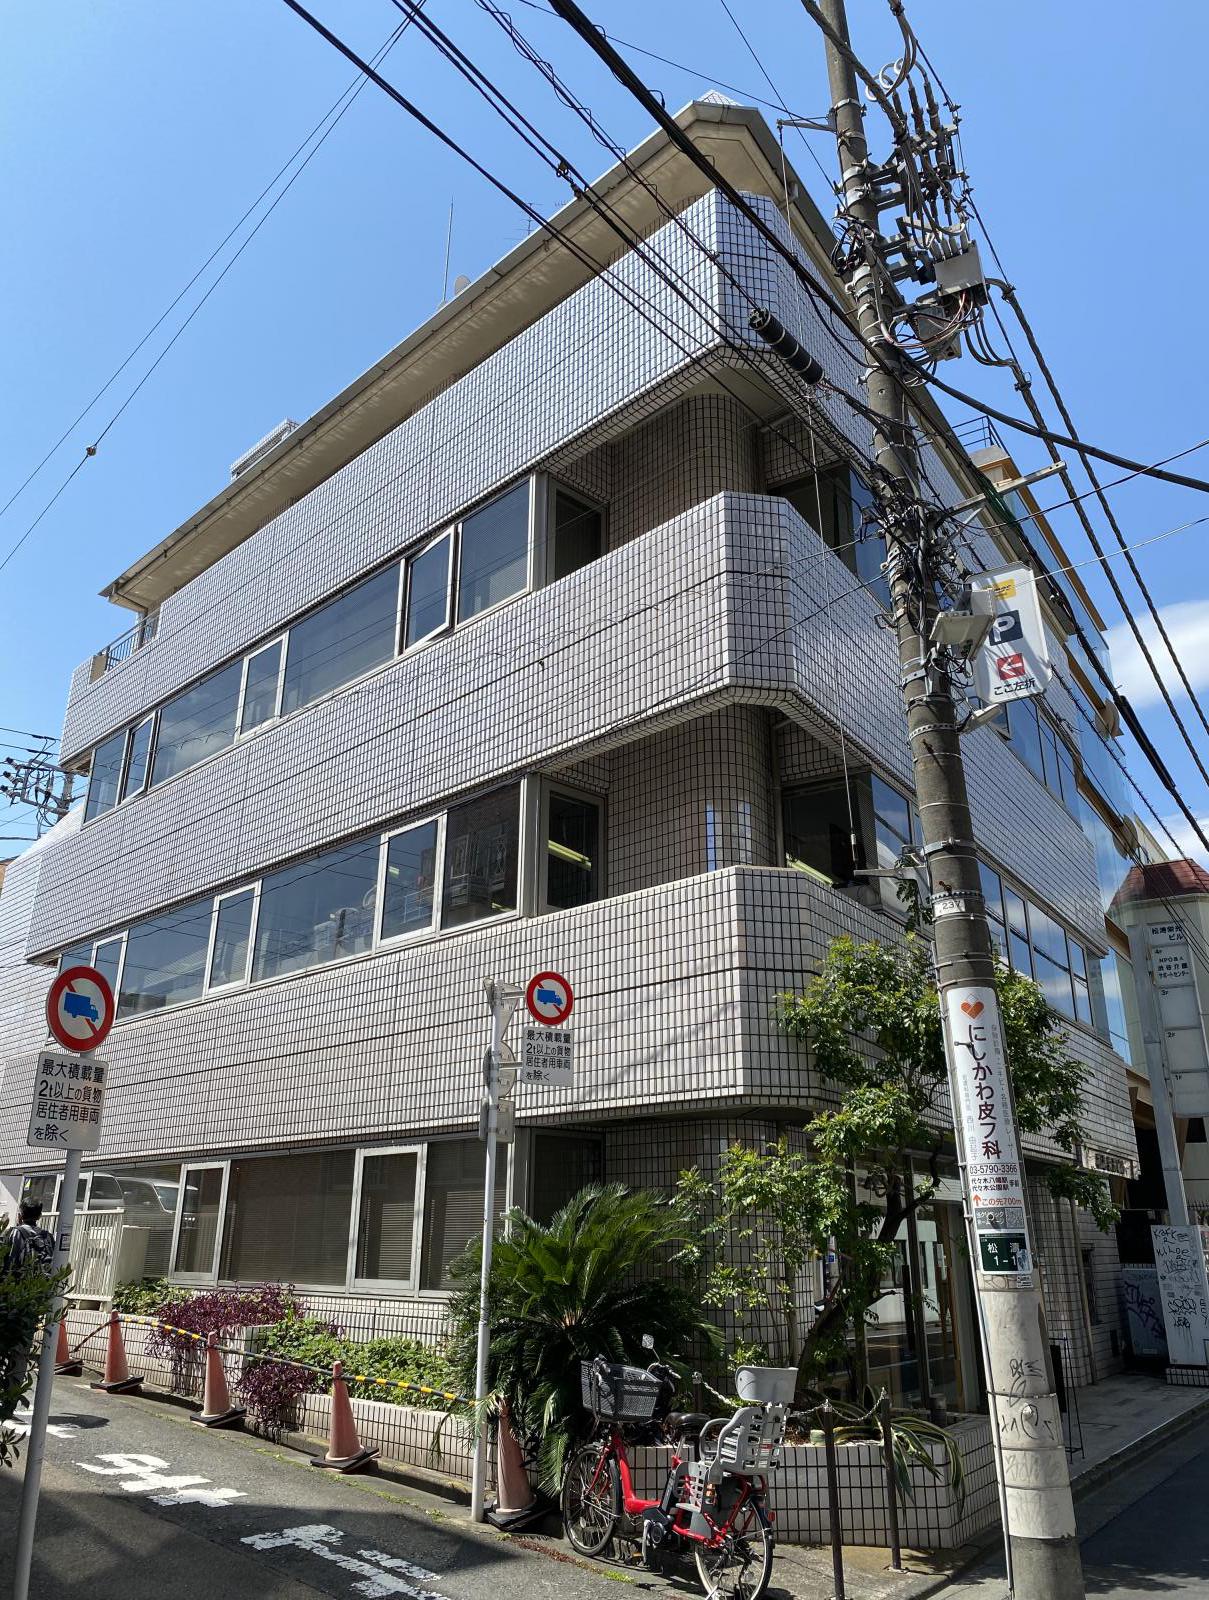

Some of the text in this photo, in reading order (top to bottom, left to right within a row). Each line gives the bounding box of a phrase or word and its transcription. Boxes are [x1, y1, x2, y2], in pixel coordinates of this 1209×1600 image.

[993, 678, 1036, 696] ここ左折
[526, 1029, 571, 1044] 最大積載量
[526, 1042, 571, 1057] 2t以上の貨物
[525, 1056, 571, 1070] 居住者用車両
[41, 1058, 105, 1084] 最大積載量
[525, 1069, 550, 1081] を除く
[38, 1079, 102, 1104] 2t以上の貨物
[967, 1024, 1002, 1160] にしかわ皮フ科
[36, 1101, 100, 1124] 居住者用車両
[34, 1124, 69, 1142] を除く
[969, 1164, 1018, 1175] 03-5790-3366
[971, 1176, 1008, 1185] 代々木八幡駅
[972, 1183, 1010, 1192] 代々木公園駅
[982, 1197, 1022, 1206] この先700m
